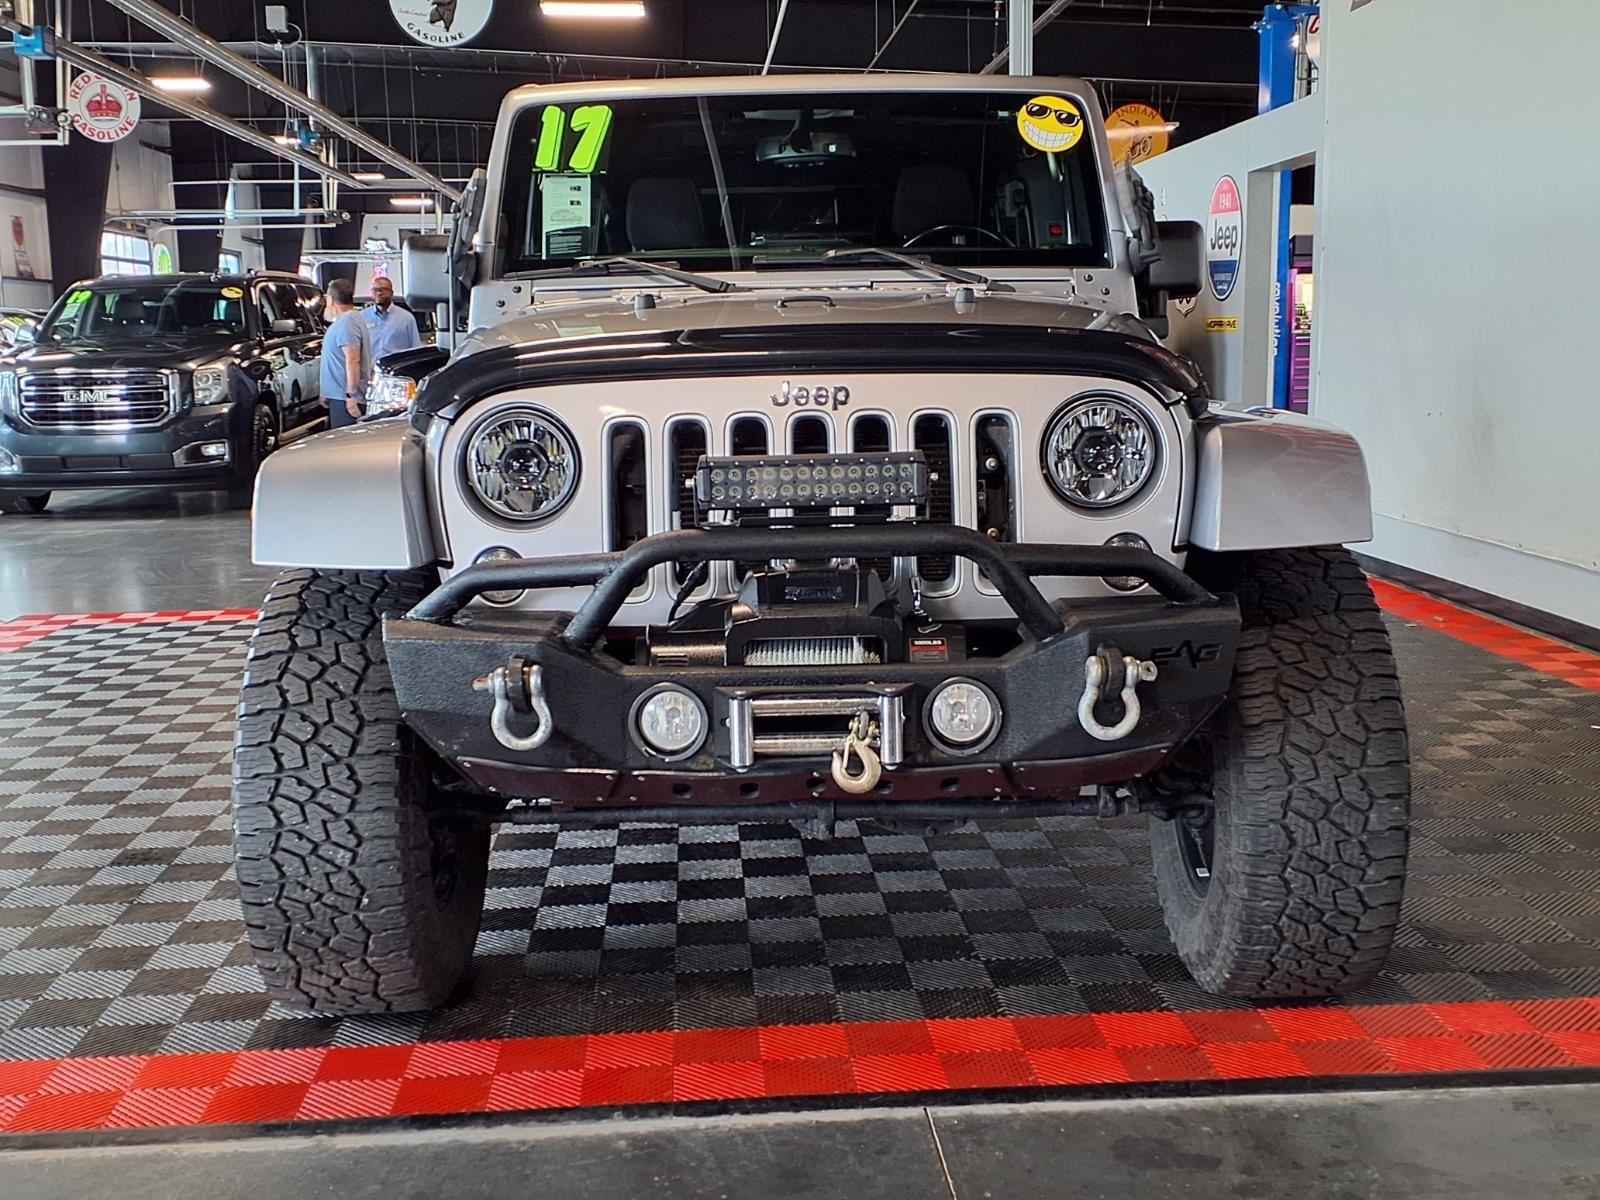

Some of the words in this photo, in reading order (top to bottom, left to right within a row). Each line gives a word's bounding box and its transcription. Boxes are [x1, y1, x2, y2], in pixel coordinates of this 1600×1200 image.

[407, 22, 465, 43] GASOLINE
[70, 74, 91, 100] RED
[1116, 105, 1157, 120] INDIAN
[73, 114, 135, 140] GASOLINE
[535, 105, 613, 173] 17
[1211, 219, 1238, 256] Jeep
[64, 389, 121, 403] GMC
[769, 381, 850, 411] Jeep
